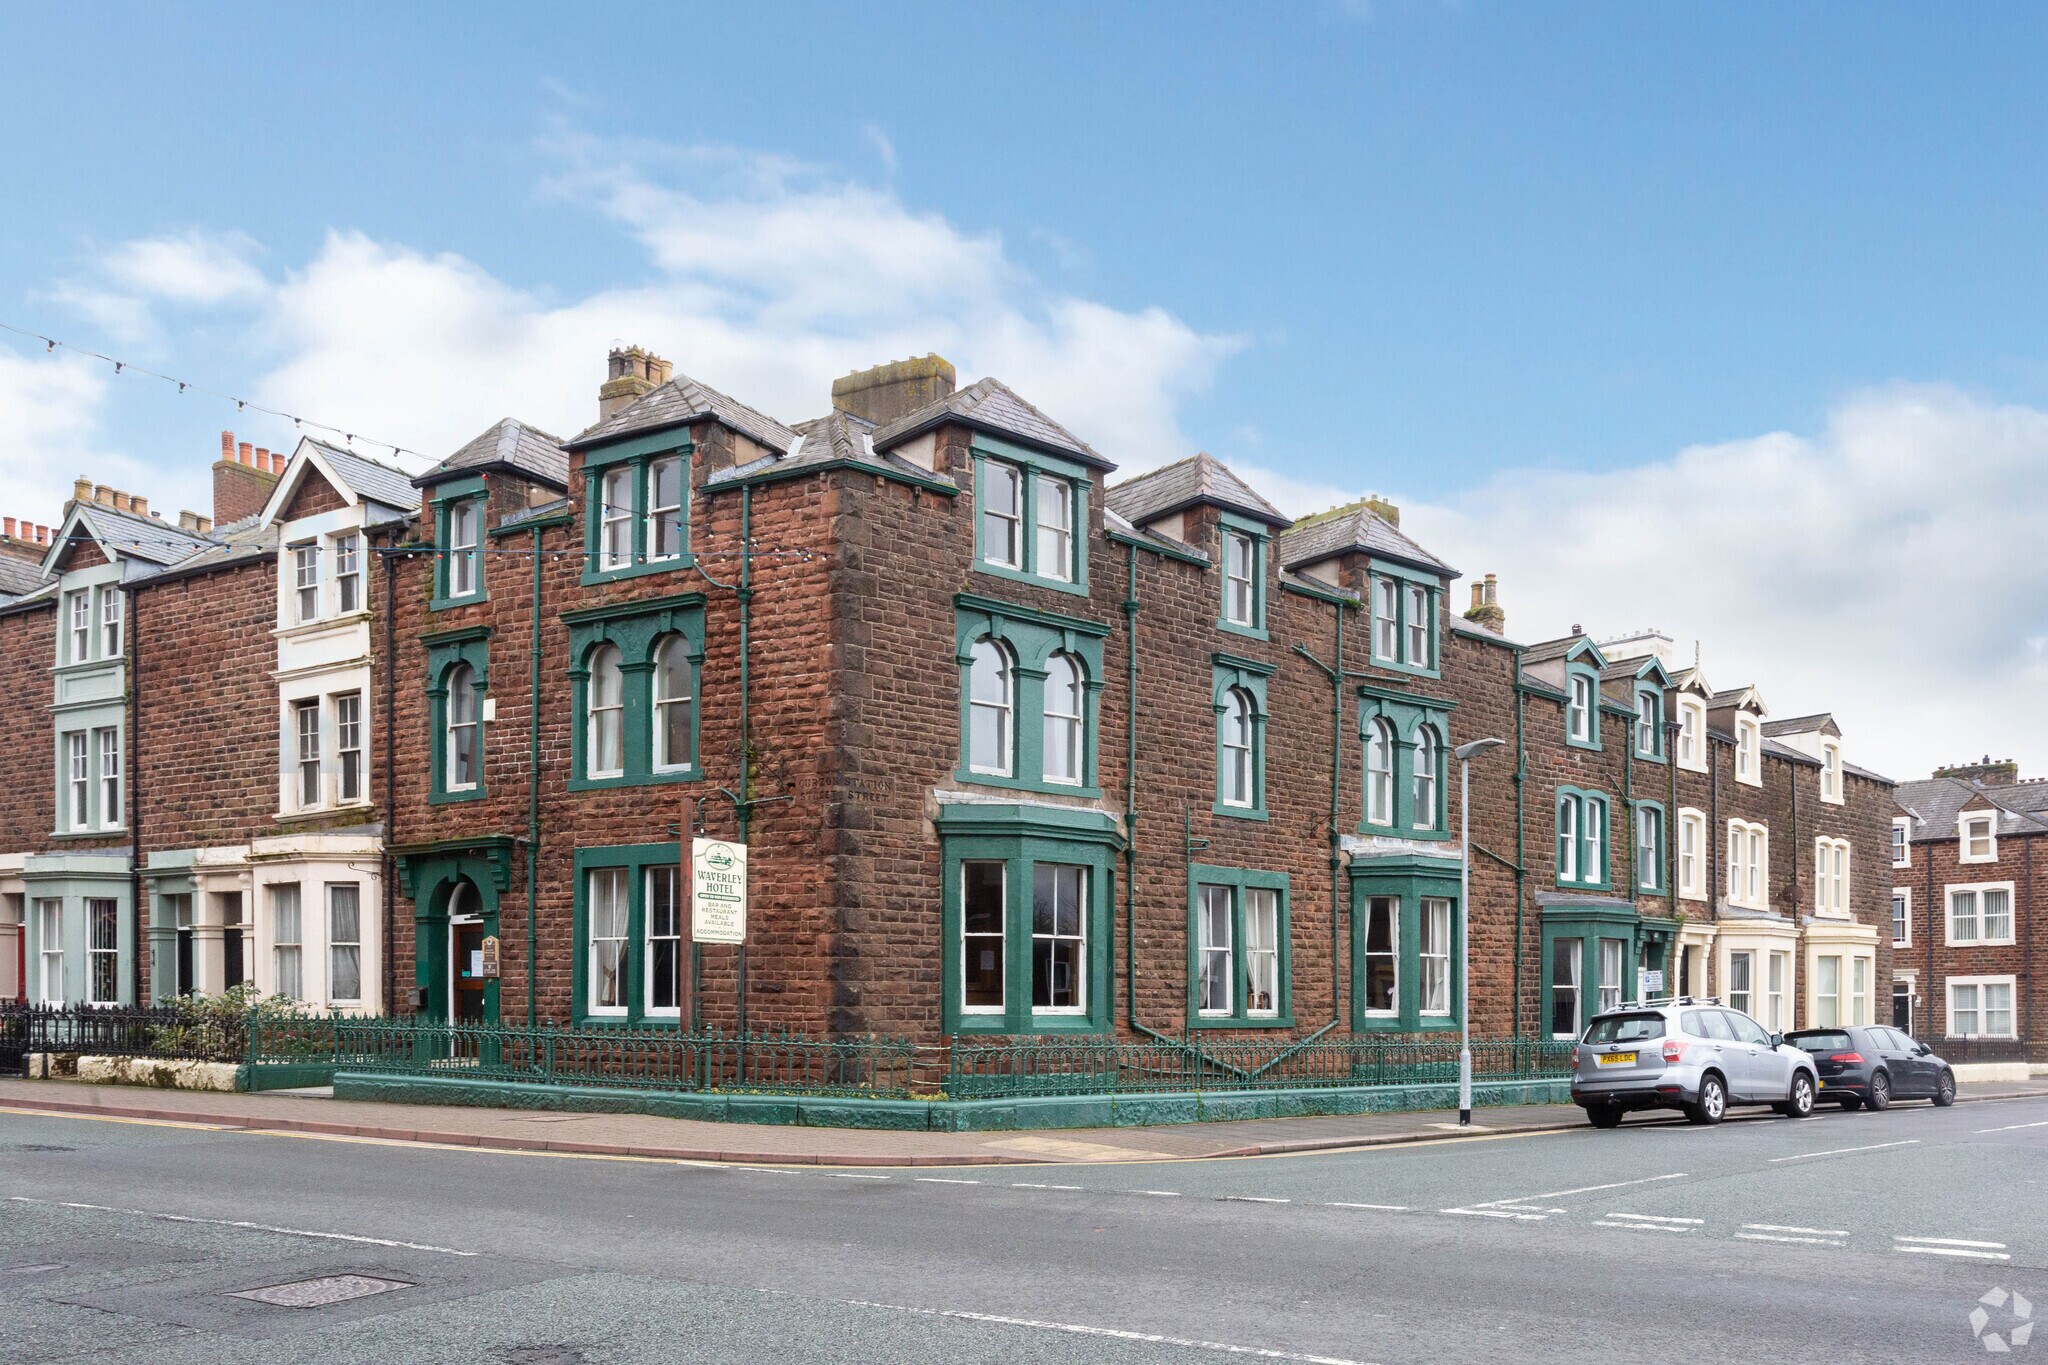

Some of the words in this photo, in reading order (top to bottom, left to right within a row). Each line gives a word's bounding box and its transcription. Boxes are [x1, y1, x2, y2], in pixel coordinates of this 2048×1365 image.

[798, 777, 839, 789] CURZON
[844, 777, 891, 790] STATION
[847, 790, 888, 802] STREET
[698, 871, 742, 884] WAVERLEY
[706, 883, 734, 894] HOTEL
